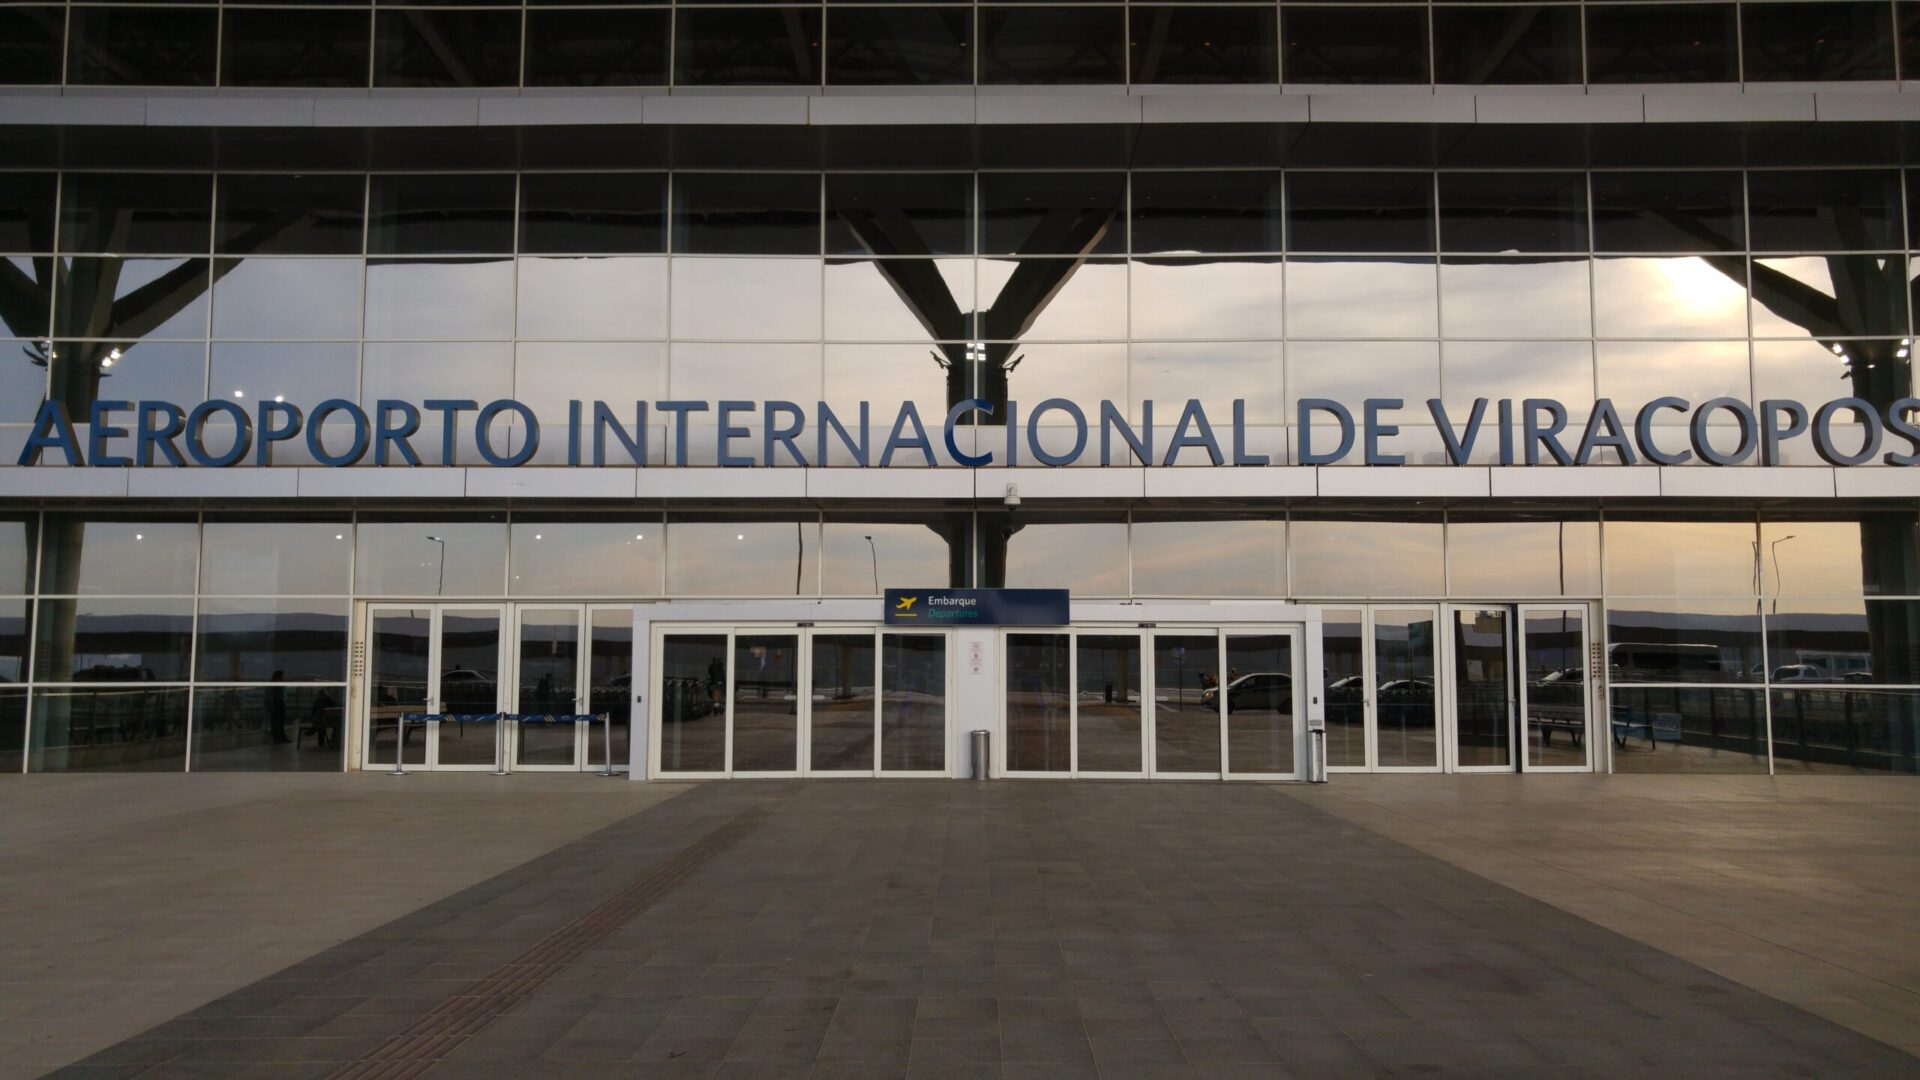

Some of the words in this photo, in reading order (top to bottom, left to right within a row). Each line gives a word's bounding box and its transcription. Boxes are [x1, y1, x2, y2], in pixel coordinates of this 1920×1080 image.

[17, 399, 539, 467] AEROPORTO
[567, 398, 1270, 466] INTERNACIONAL
[1298, 398, 1406, 466] DE
[1426, 396, 1920, 466] VIRACOPOS
[928, 595, 977, 607] Embarque
[928, 608, 978, 618] Departures
